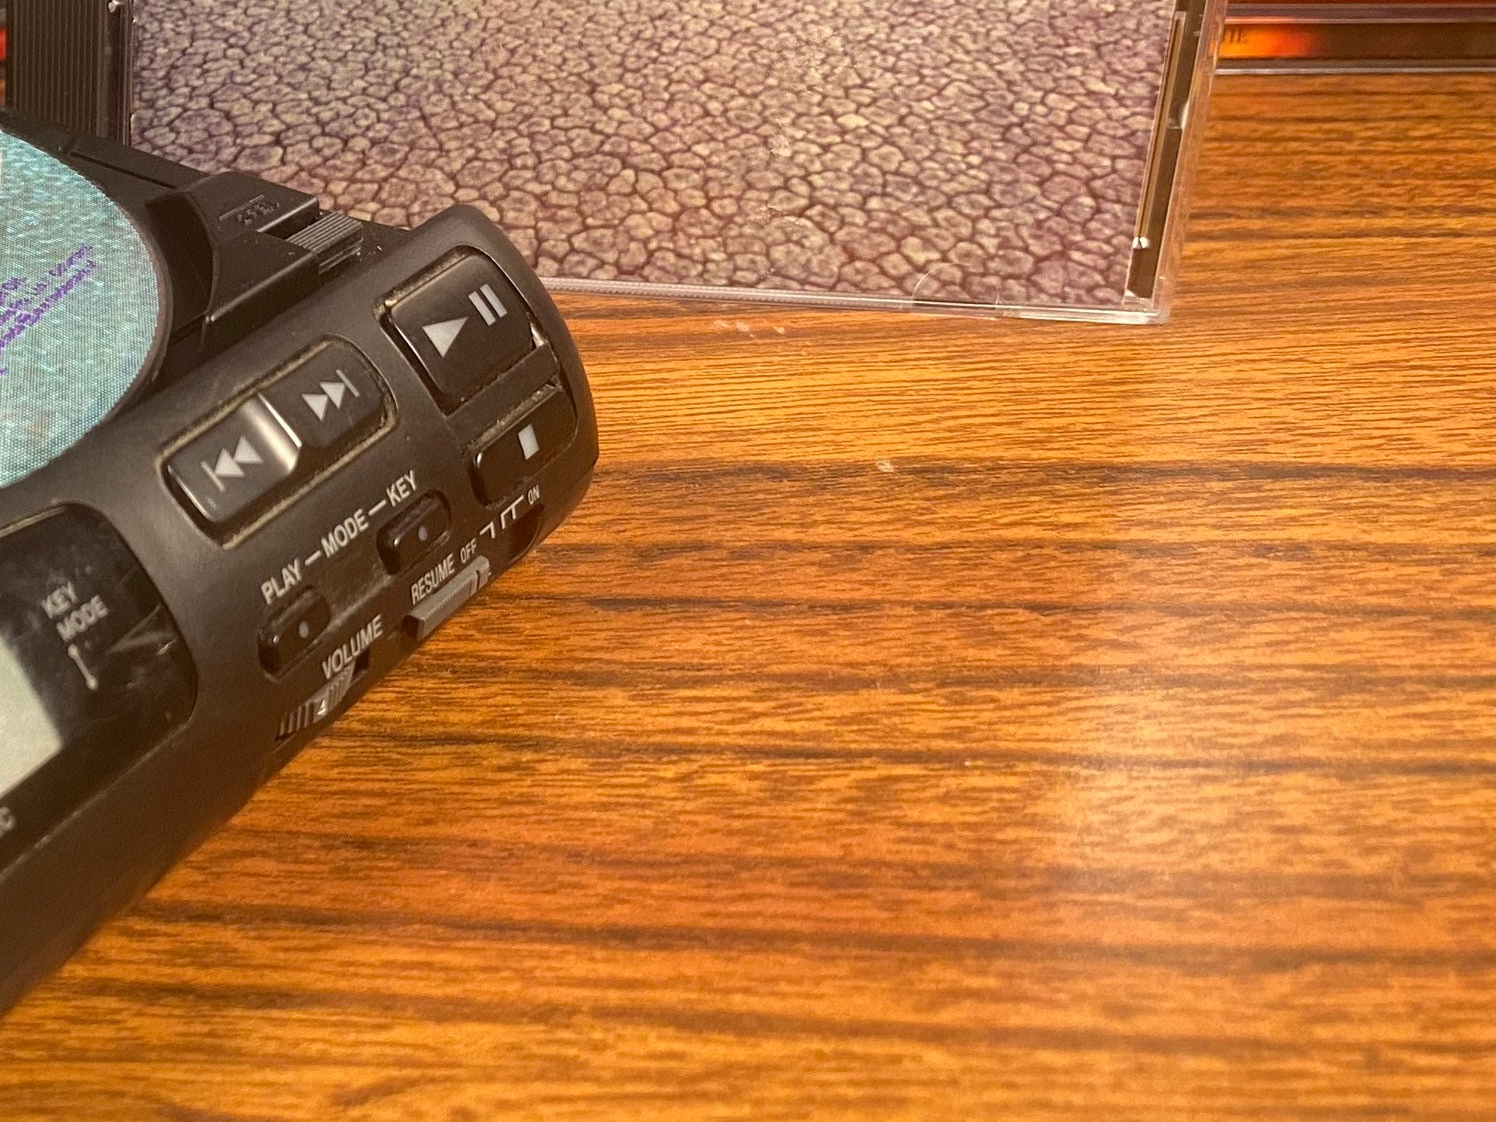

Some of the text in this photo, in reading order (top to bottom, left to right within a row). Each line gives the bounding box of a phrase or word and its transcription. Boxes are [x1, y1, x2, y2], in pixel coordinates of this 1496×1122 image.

[259, 469, 419, 606] PLAY MODE KEY
[409, 485, 542, 606] RESUME OFF ON
[41, 580, 79, 620] KEY
[56, 594, 111, 643] MODE
[320, 613, 385, 680] VOLUME
